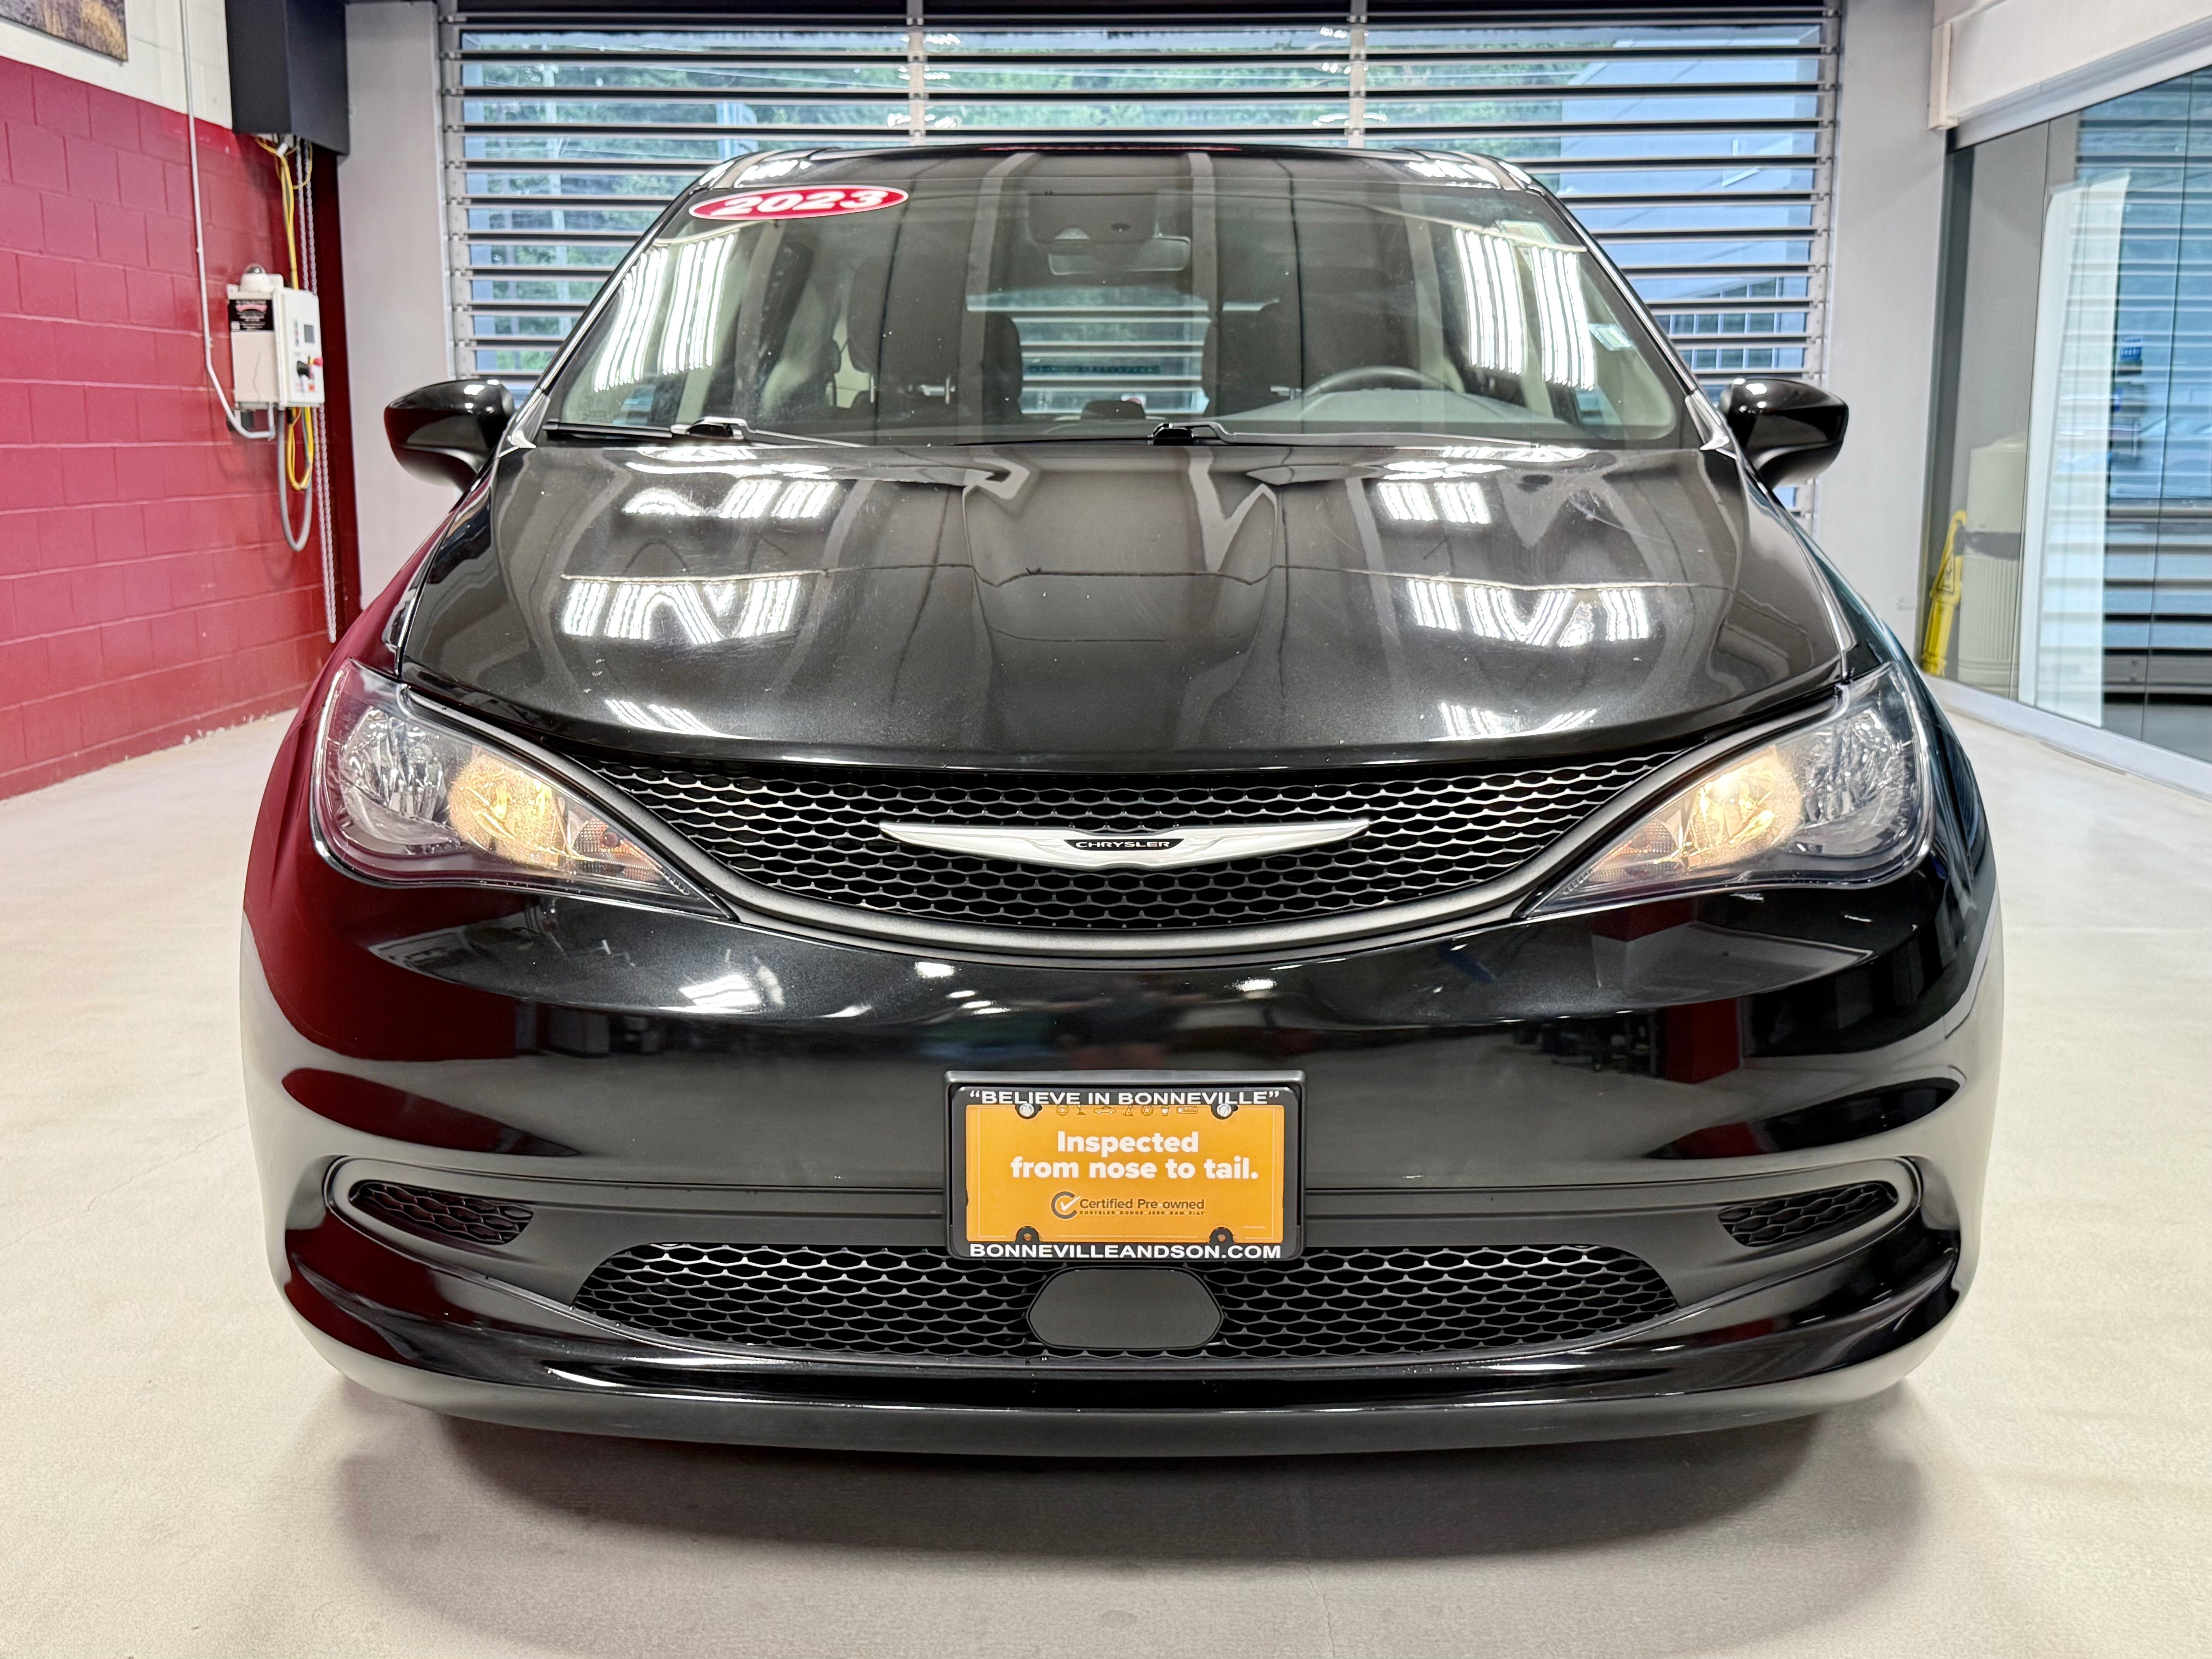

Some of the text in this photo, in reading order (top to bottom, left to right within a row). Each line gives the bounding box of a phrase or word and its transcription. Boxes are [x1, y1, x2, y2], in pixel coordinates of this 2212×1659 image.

[710, 190, 888, 216] 2023
[1088, 1092, 1109, 1104] IN
[1057, 1130, 1199, 1157] Inspected
[1010, 1155, 1259, 1179] from nose to tail.
[1080, 1198, 1133, 1209] Certified
[970, 1243, 1281, 1259] BONNEVILLEANDSON.COM
